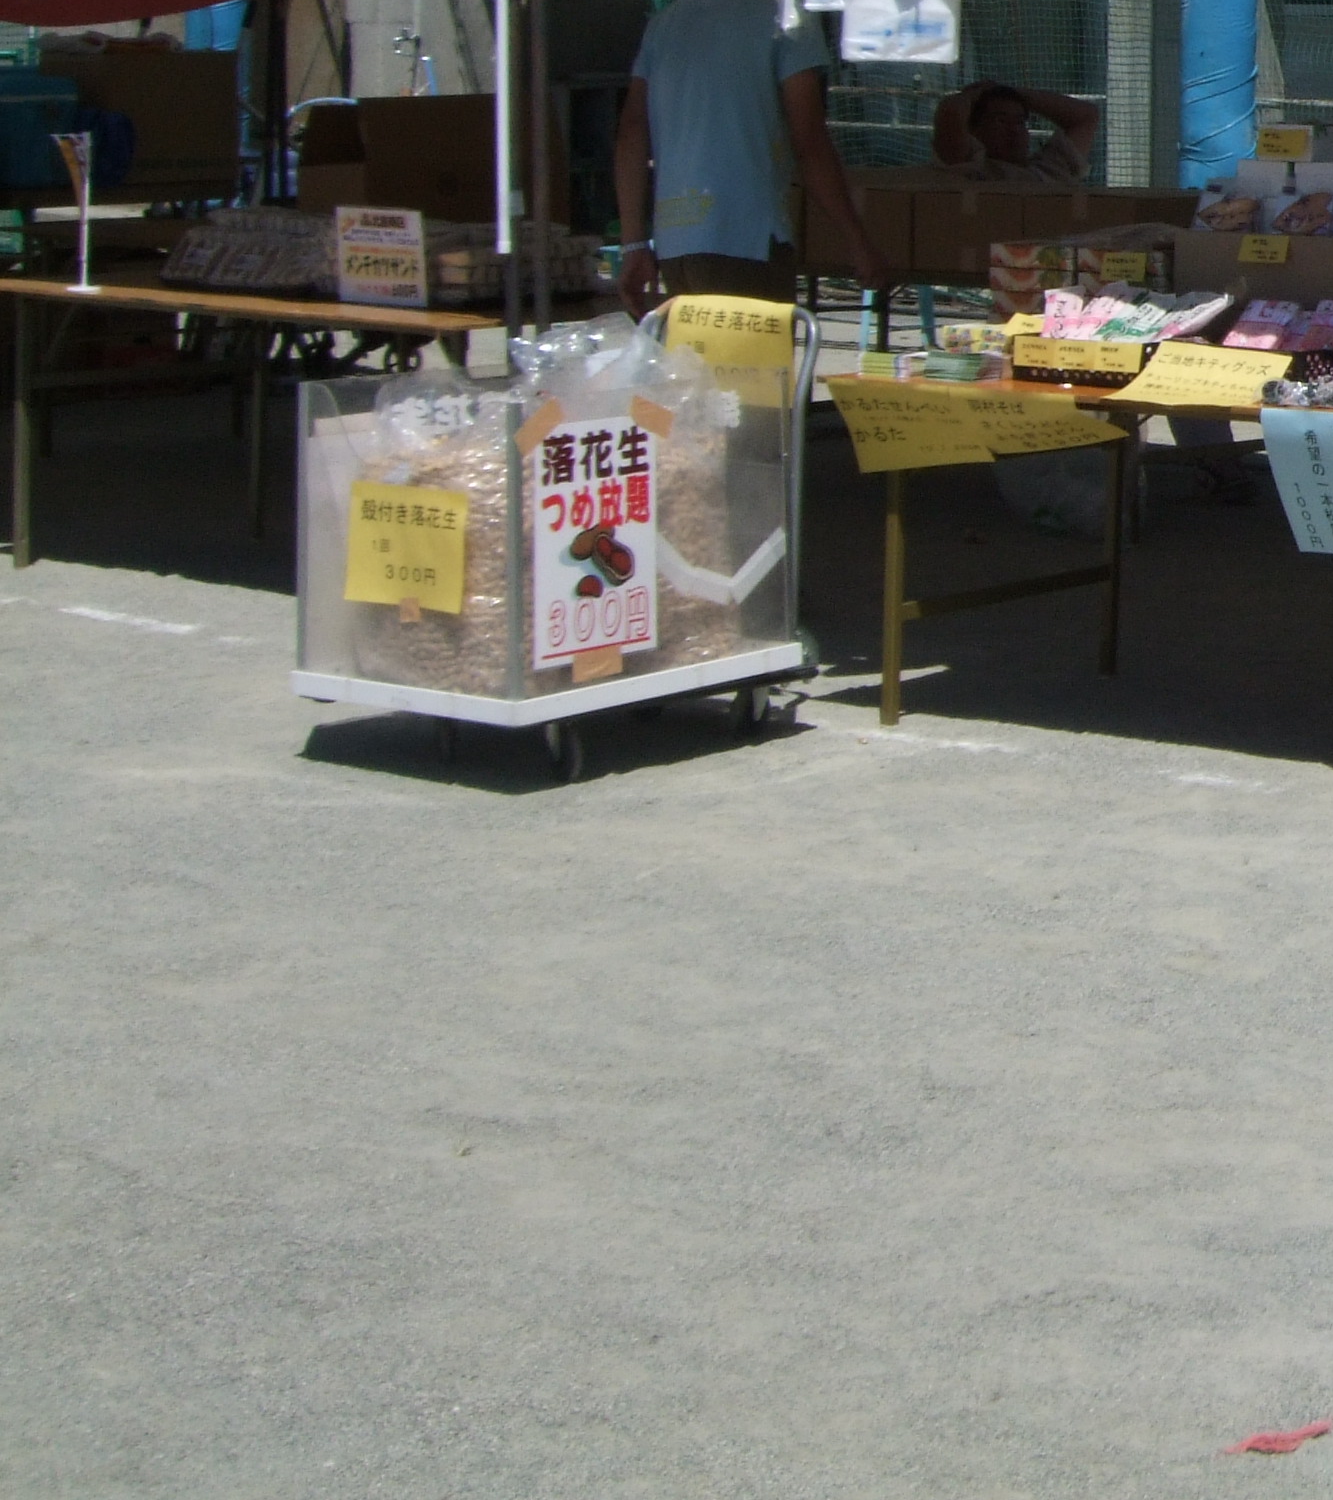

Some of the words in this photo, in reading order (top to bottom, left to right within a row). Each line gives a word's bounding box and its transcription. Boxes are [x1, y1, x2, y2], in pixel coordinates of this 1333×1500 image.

[678, 304, 782, 335] 殻付き落花生
[541, 425, 651, 487] 落花生
[541, 474, 651, 532] つめ放題
[384, 563, 436, 587] 300円
[546, 584, 651, 647] 300円
